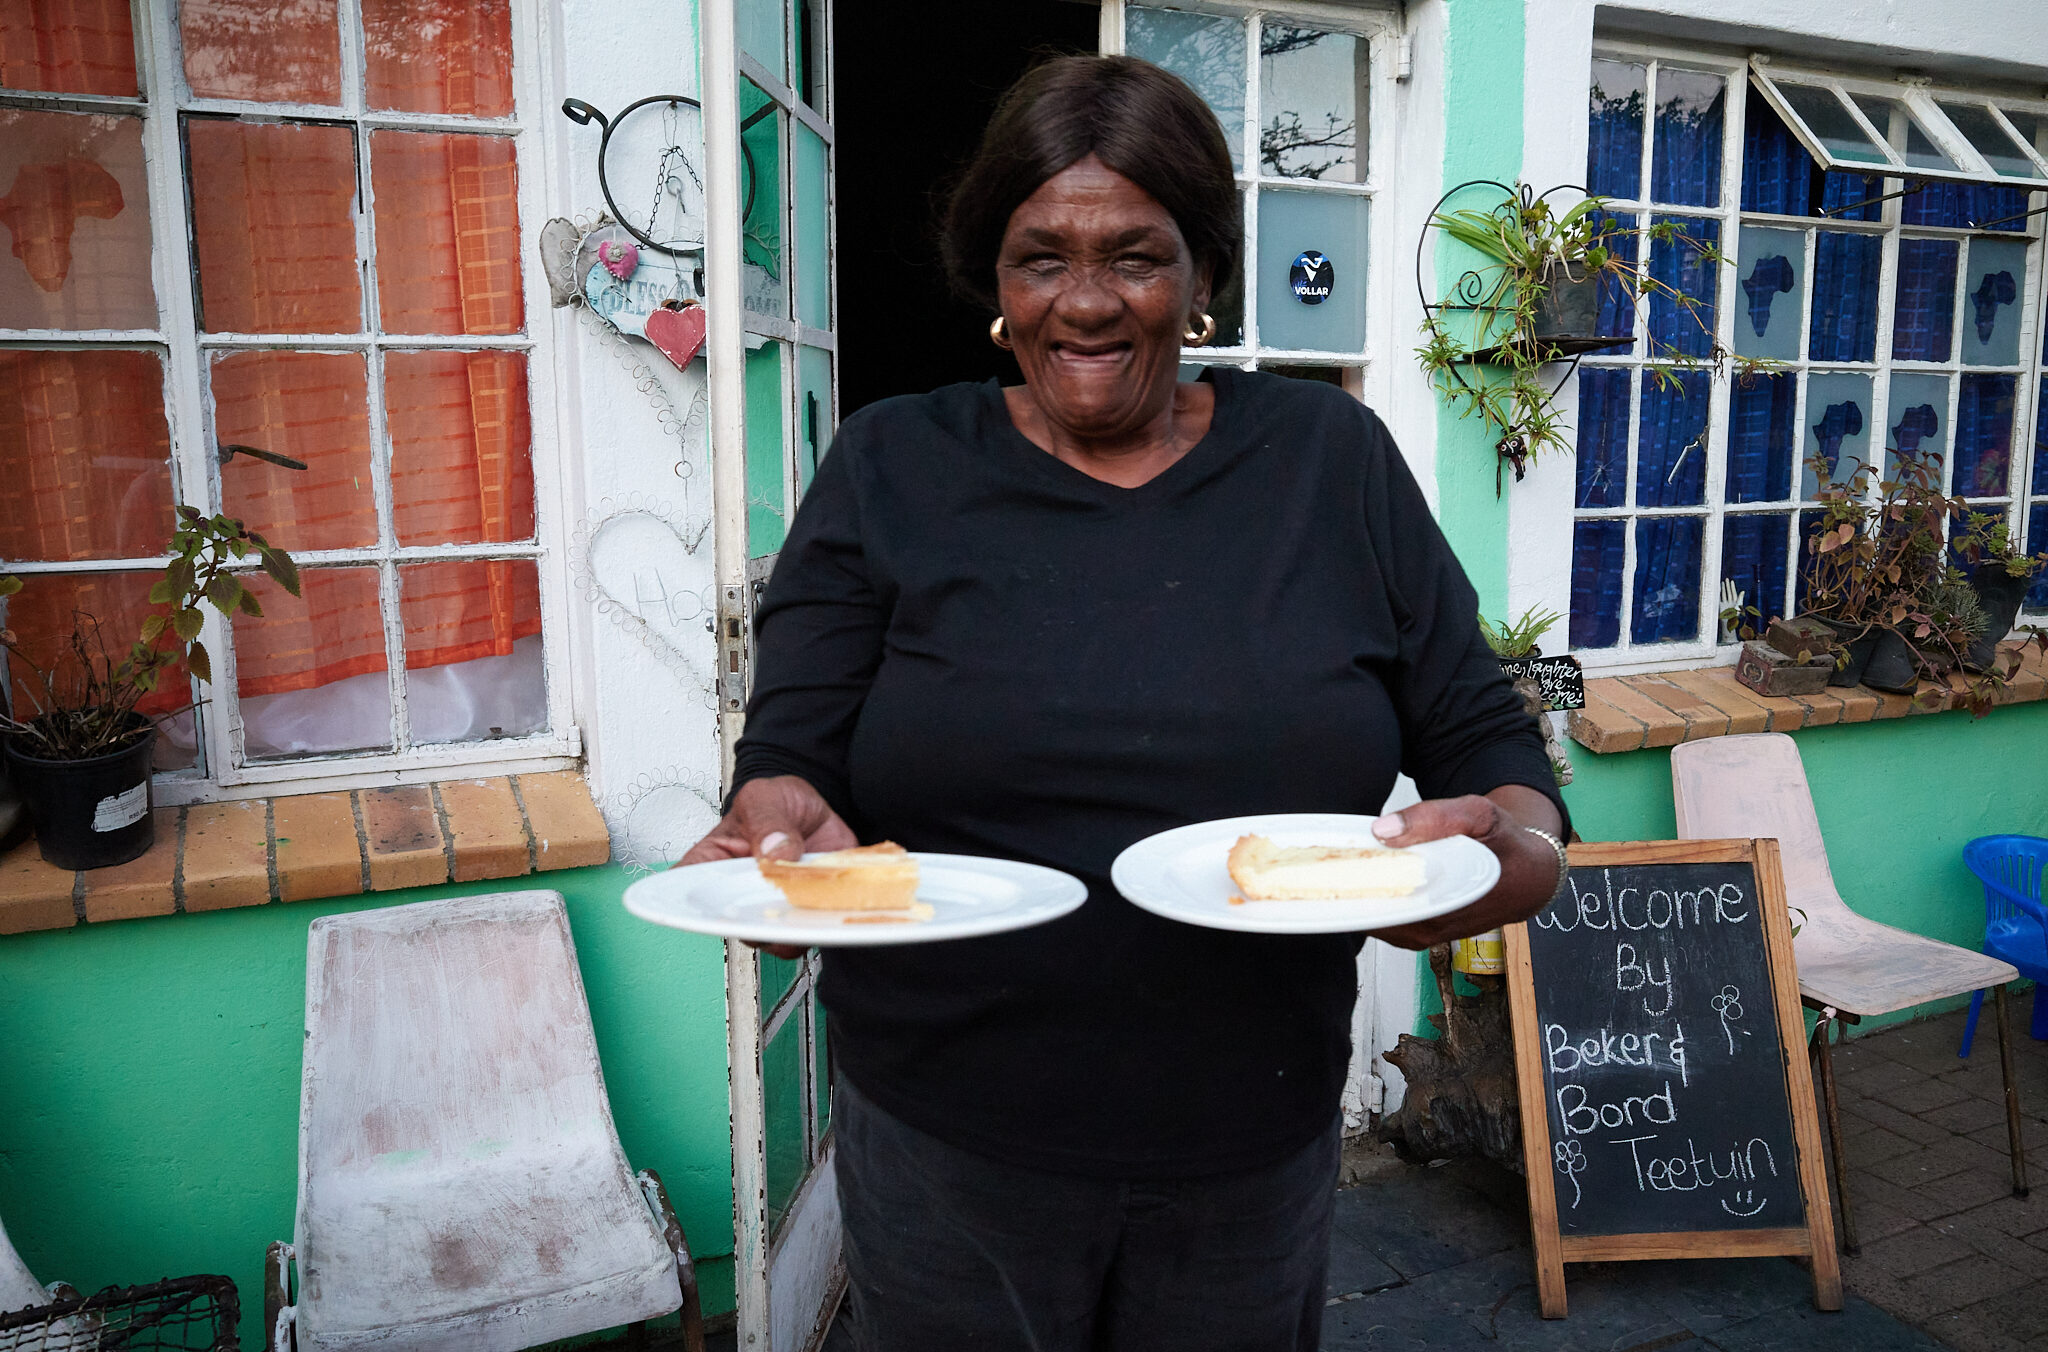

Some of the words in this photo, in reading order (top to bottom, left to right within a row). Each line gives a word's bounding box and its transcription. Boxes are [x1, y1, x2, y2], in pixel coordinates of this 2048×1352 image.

[1294, 286, 1329, 296] VOLLAR
[1527, 660, 1583, 684] laughter
[1539, 689, 1584, 705] come!
[1534, 868, 1749, 933] Welcome
[1615, 943, 1673, 1017] By
[1545, 1023, 1663, 1075] Beker
[1669, 1023, 1689, 1088] &
[1556, 1080, 1678, 1136] Bord
[1609, 1133, 1778, 1193] Teetuin
